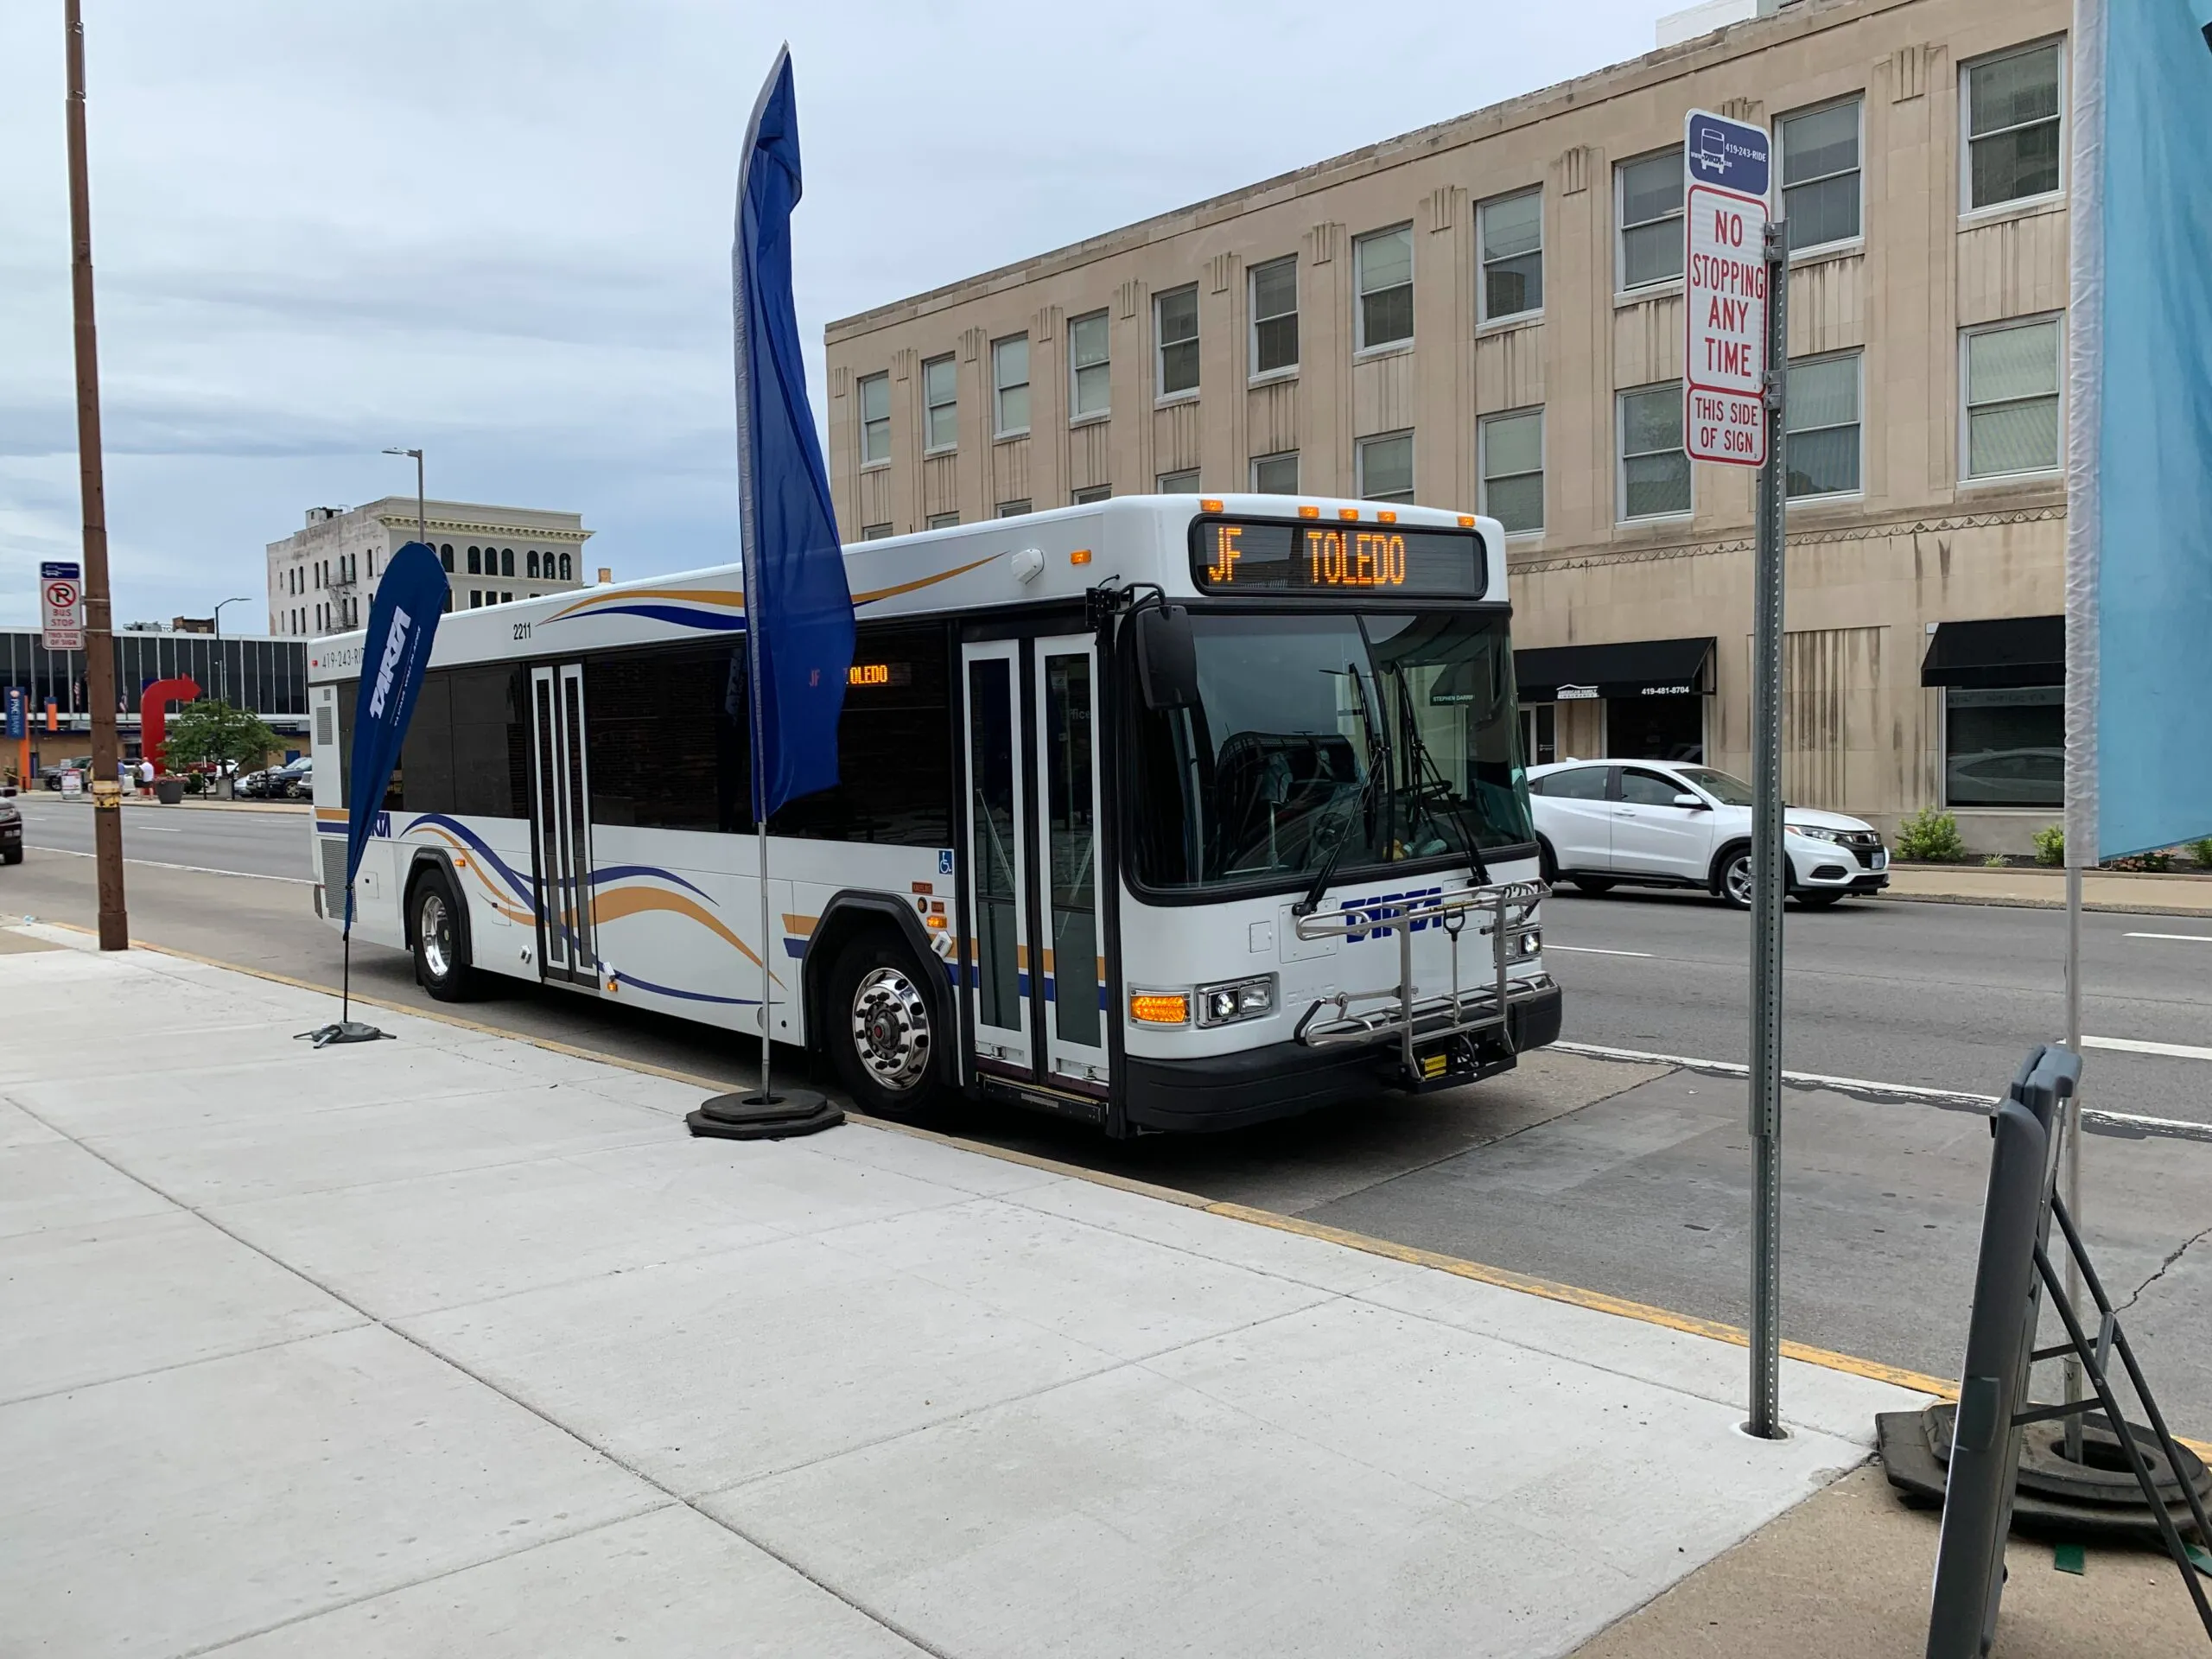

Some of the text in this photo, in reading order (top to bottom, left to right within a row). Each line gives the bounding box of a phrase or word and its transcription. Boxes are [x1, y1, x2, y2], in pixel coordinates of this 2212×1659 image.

[1726, 143, 1766, 162] 419-243-RIDE
[1715, 209, 1743, 248] NO
[1693, 252, 1764, 300] STOPPING
[1708, 296, 1749, 334] ANY
[1705, 337, 1751, 378] TIME
[1695, 397, 1758, 426] THIS SIDE
[1700, 426, 1753, 454] OF SIGN
[1208, 526, 1406, 585] JF TOLEDO
[53, 608, 72, 617] BUS
[513, 621, 531, 640] 2211
[369, 605, 411, 720] TARTA
[1641, 686, 1690, 695] 419-481-8704
[1340, 887, 1442, 944] TARTA
